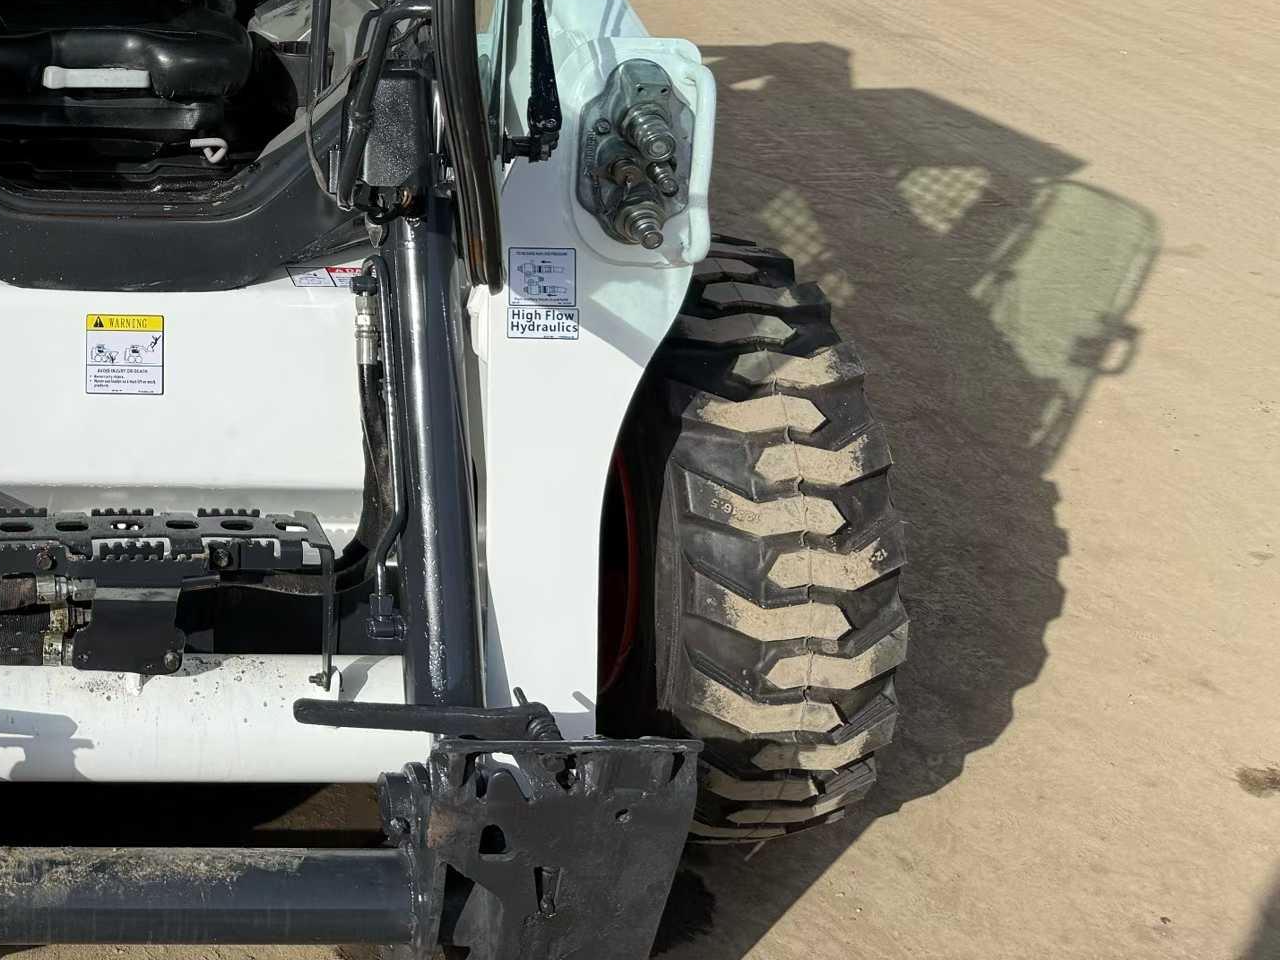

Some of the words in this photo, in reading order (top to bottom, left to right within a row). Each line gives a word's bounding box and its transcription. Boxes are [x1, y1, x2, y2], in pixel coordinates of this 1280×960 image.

[512, 309, 541, 322] High
[545, 310, 575, 321] Flow
[108, 317, 148, 329] WARNING
[510, 321, 578, 334] Hydraulics
